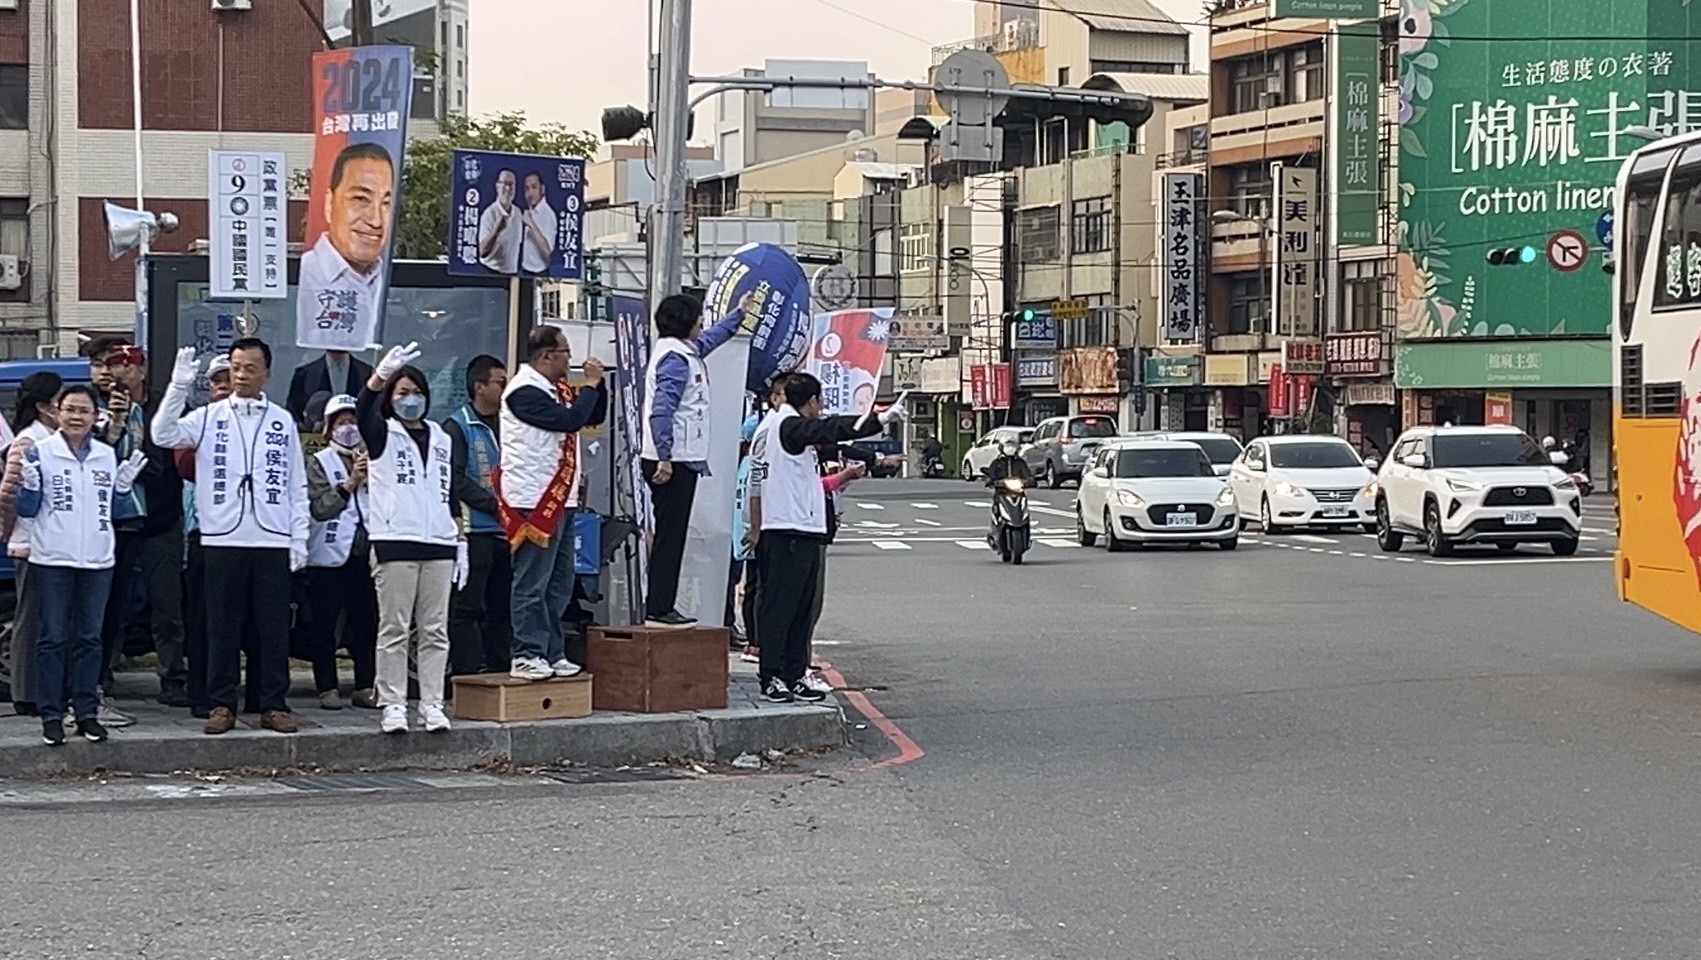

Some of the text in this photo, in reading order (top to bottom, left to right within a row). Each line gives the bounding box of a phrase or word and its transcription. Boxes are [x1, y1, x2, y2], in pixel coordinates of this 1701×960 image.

[323, 58, 400, 112] 2024
[1501, 51, 1674, 88] 生活態度の衣著
[322, 111, 399, 135] 台灣再出發
[231, 174, 246, 194] 9
[1459, 180, 1617, 215] Cotton linen
[232, 220, 248, 291] 中國國民黨
[1170, 181, 1192, 333] 玉津名品廣場
[1284, 200, 1308, 285] 美利達
[265, 449, 282, 505] 侯友宜
